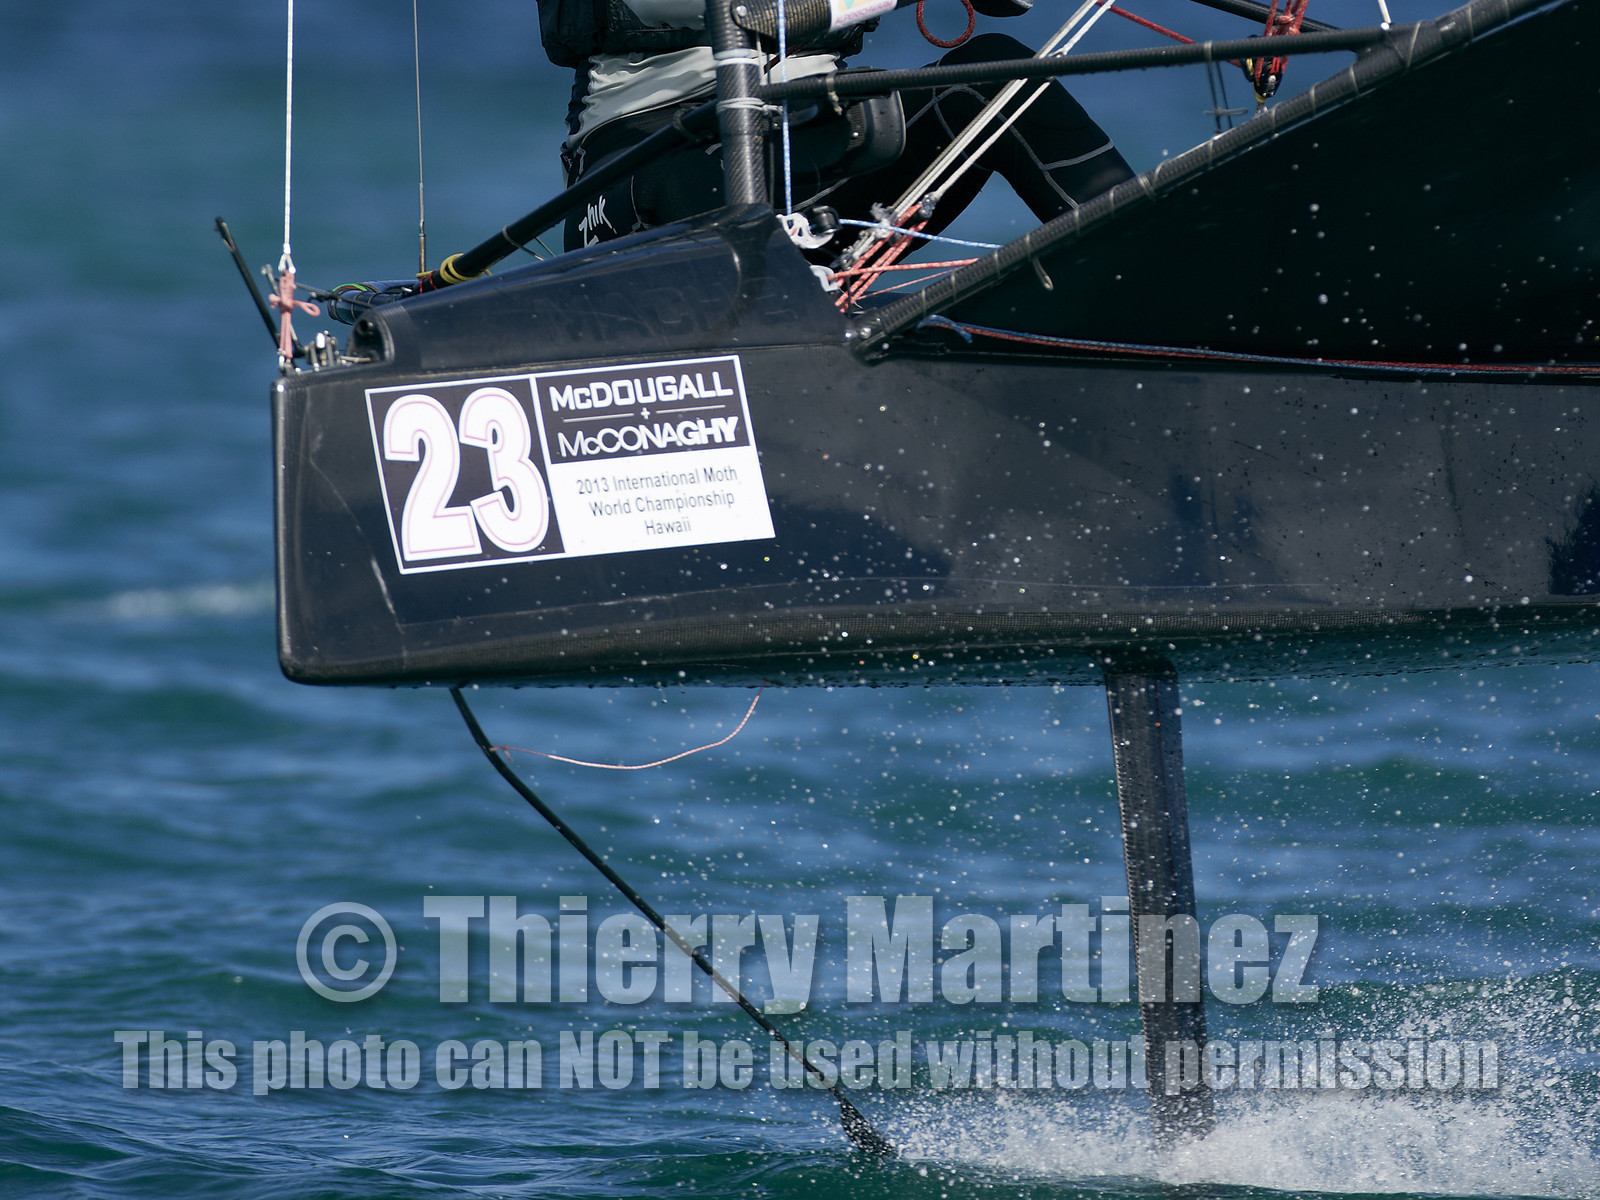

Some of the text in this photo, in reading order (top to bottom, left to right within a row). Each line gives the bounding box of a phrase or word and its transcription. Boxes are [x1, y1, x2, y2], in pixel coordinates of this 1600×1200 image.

[558, 416, 739, 457] McCONAGHY
[383, 387, 549, 562] 23
[576, 465, 738, 495] 2013 International Moth
[589, 490, 736, 518] World Championship
[645, 516, 692, 536] Hawaii
